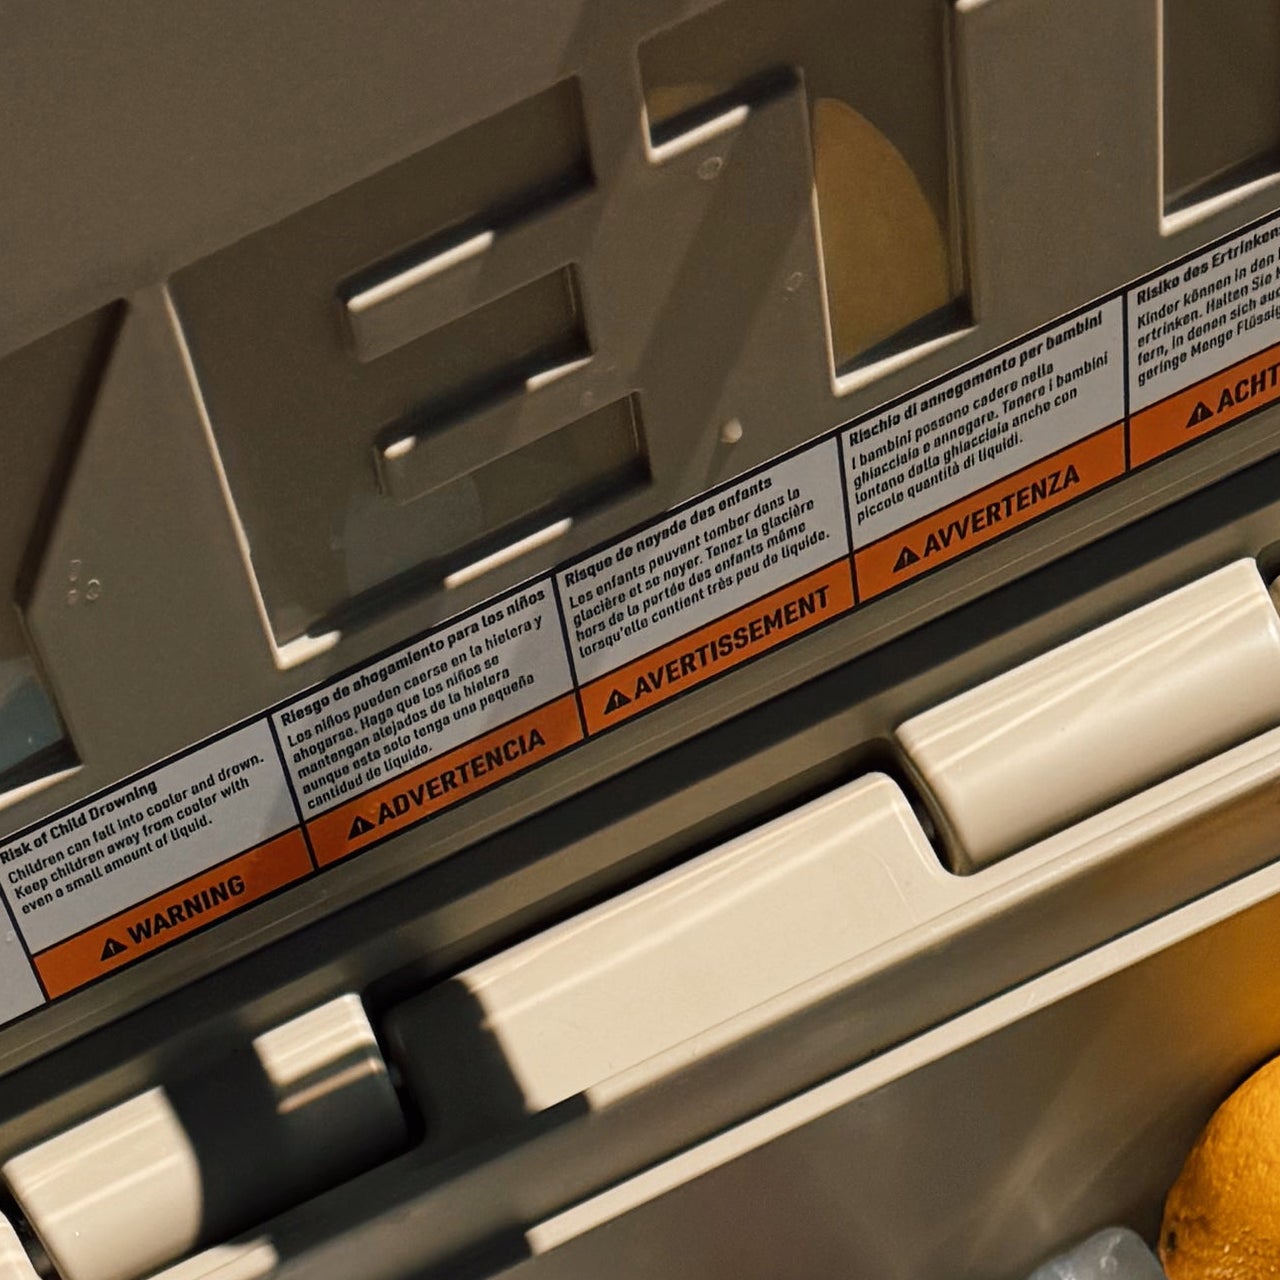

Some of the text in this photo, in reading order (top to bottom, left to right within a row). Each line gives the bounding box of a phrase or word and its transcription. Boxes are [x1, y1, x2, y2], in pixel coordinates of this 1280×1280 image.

[1135, 274, 1180, 306] Risiko
[1182, 260, 1210, 283] des
[1136, 298, 1181, 330] Kinder
[1182, 273, 1232, 308] können
[1233, 266, 1247, 283] in
[1249, 252, 1275, 274] den
[1136, 308, 1203, 348] ertrinken.
[1204, 283, 1249, 315] Halten
[1250, 271, 1273, 292] Sie
[1136, 343, 1169, 367] fern,
[1170, 333, 1184, 350] in
[1185, 312, 1227, 342] denen
[1228, 296, 1257, 321] sich
[1189, 327, 1234, 358] Menge
[922, 463, 1080, 558] AVVERTENZA
[279, 694, 331, 727] Riesgo
[331, 684, 351, 702] de
[445, 621, 481, 649] para
[479, 608, 505, 628] los
[504, 588, 546, 617] niños
[285, 613, 542, 748] Los niños pueden caerse en la hielera y
[633, 584, 829, 700] AVERTISSEMENT
[291, 653, 500, 764] ahogarse. Haga que los niños se
[301, 763, 351, 795] aunque
[381, 733, 412, 755] solo
[411, 714, 451, 740] tenga
[451, 700, 478, 721] una
[477, 672, 535, 712] pequeña
[428, 698, 447, 715] de
[446, 691, 462, 705] la
[461, 666, 511, 698] hielera
[6, 753, 265, 884] Children can fall into cooler and drown.
[32, 830, 49, 849] of
[48, 810, 88, 840] Child
[86, 779, 158, 822] Drowning
[306, 743, 433, 811] cantidad de líquido.
[377, 727, 546, 826] ADVERTENCIA
[12, 775, 250, 900] Keep children away from cooler with
[20, 812, 213, 915] even a small amount of liquid.
[125, 874, 246, 945] WARNING
